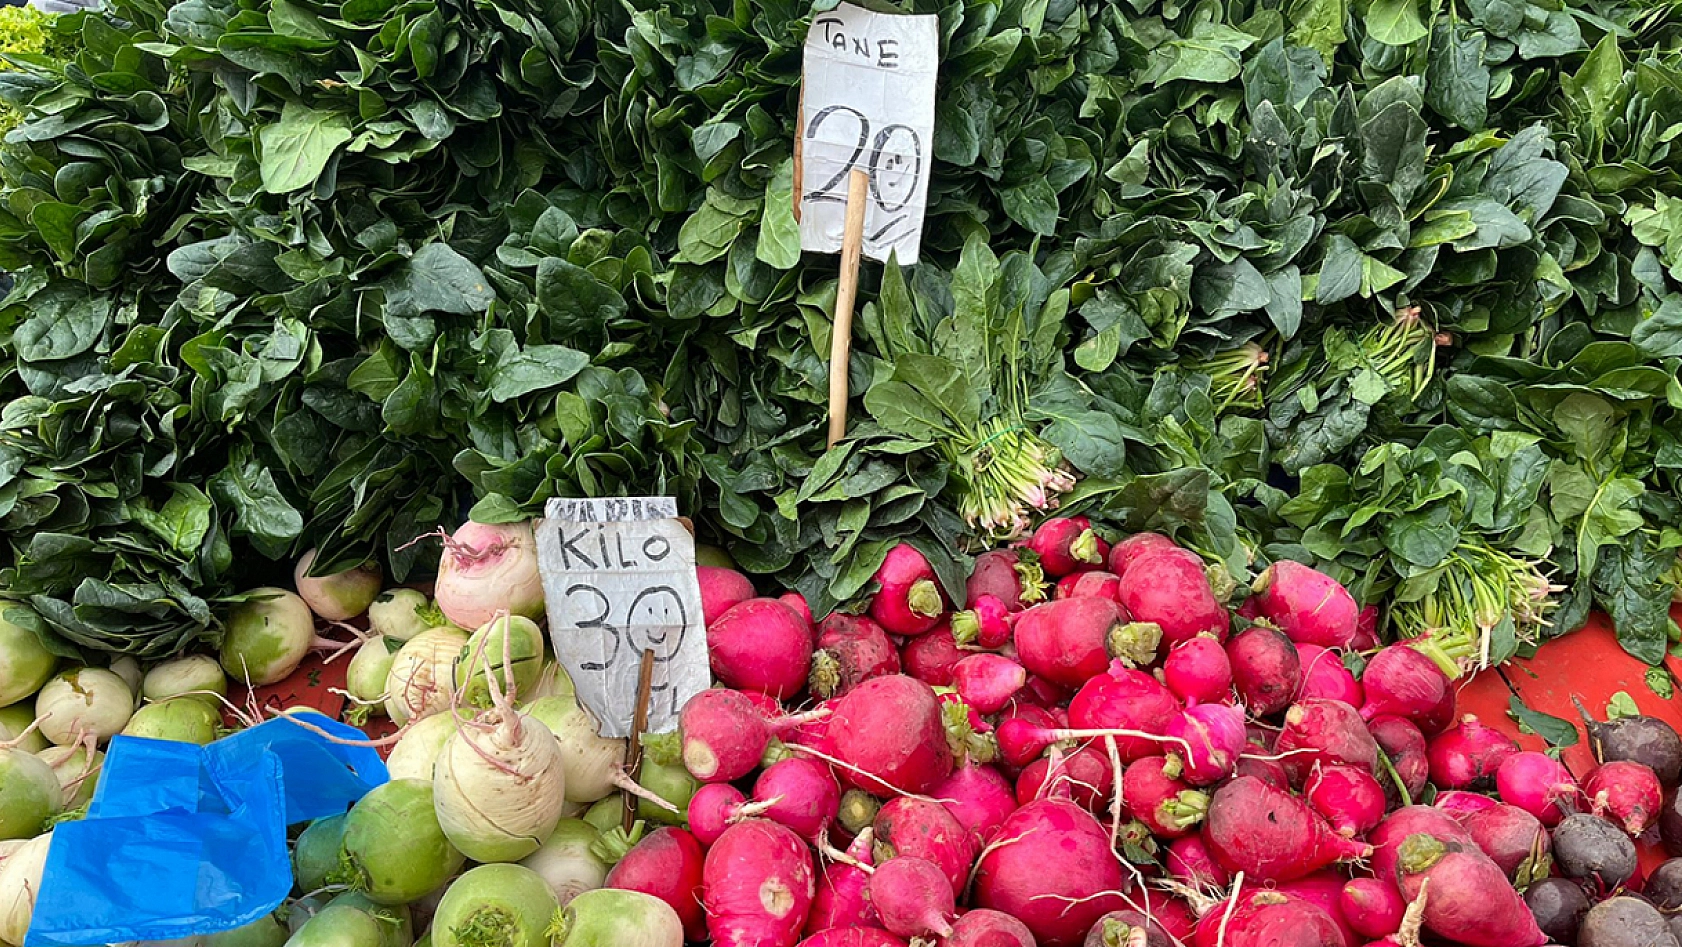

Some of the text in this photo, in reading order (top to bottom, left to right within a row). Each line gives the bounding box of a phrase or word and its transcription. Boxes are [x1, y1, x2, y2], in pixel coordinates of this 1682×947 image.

[816, 18, 899, 67] TANE
[803, 105, 921, 213] 20
[565, 583, 687, 671] 30
